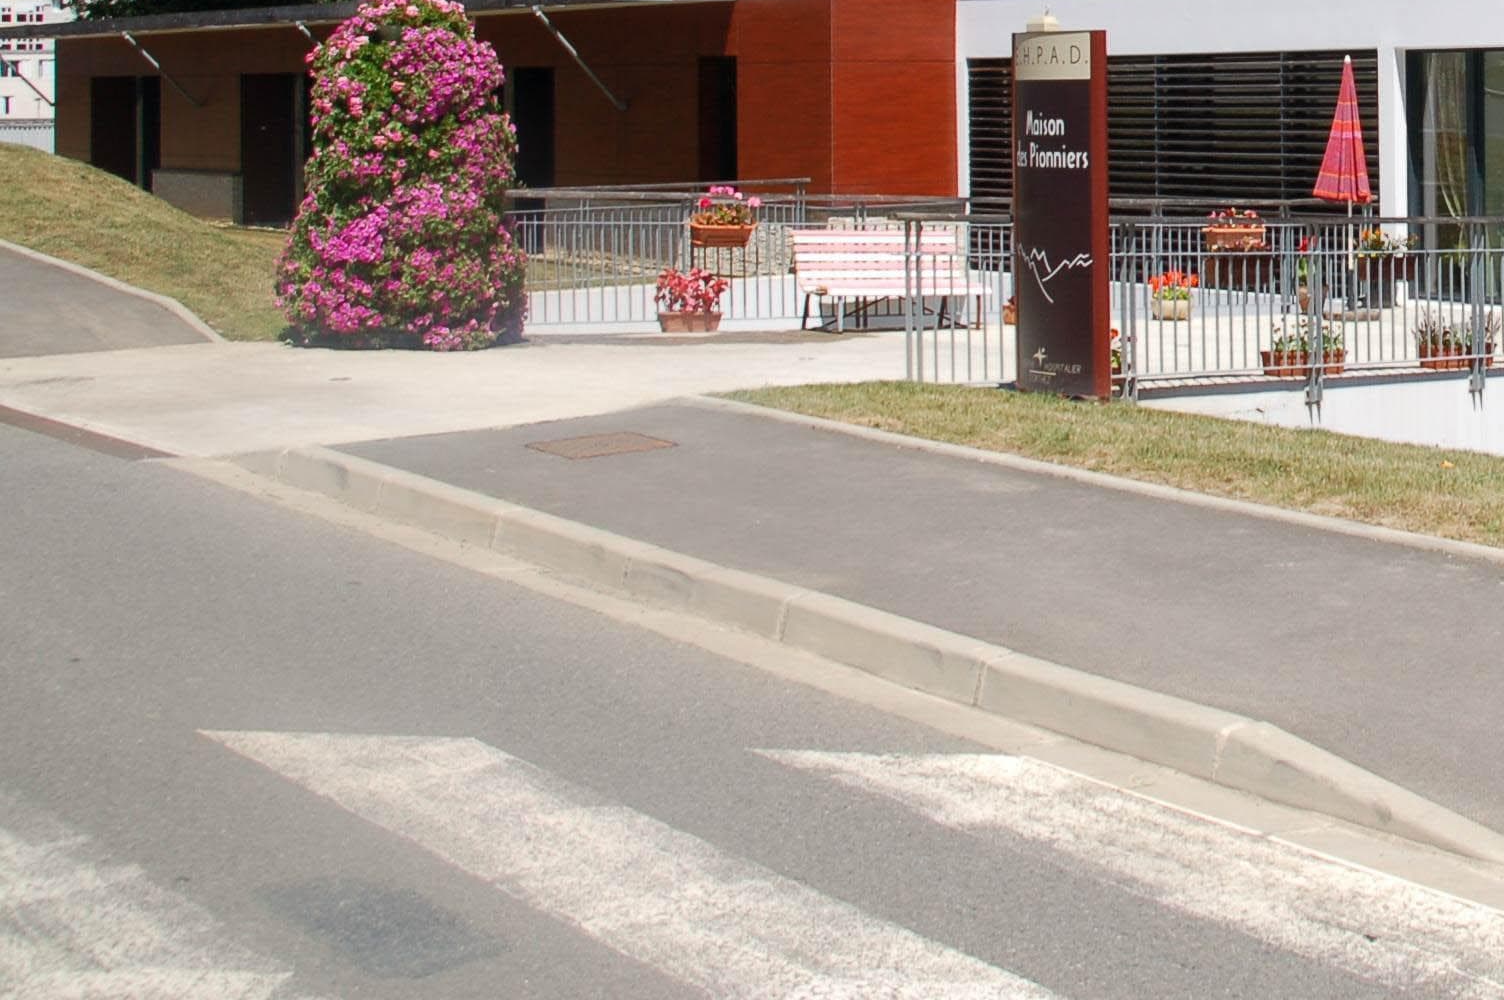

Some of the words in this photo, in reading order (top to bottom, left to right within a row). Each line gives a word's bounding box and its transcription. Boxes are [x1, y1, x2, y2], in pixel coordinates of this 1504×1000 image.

[1025, 109, 1065, 136] Maison
[1016, 140, 1028, 168] des
[1029, 142, 1089, 169] Pionniers
